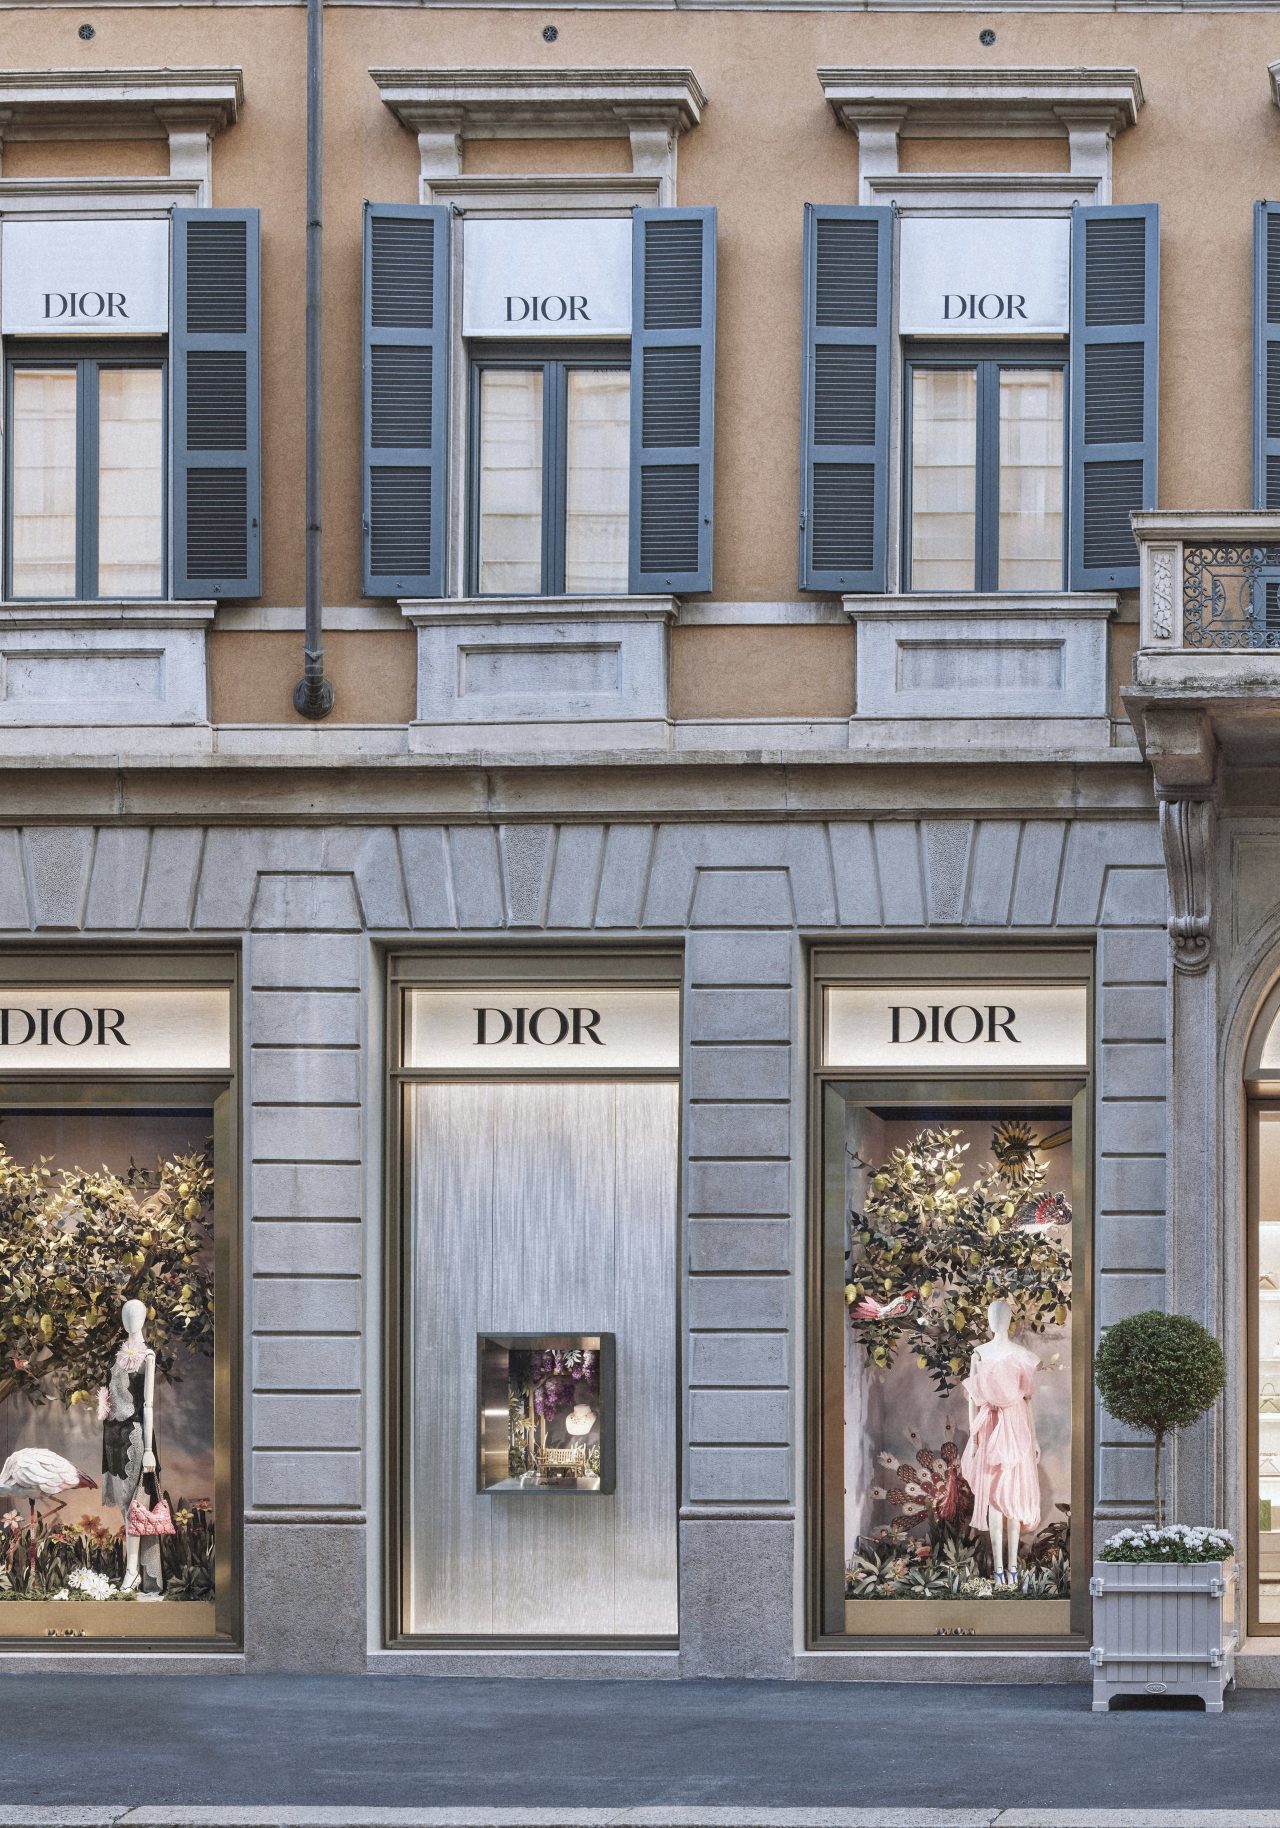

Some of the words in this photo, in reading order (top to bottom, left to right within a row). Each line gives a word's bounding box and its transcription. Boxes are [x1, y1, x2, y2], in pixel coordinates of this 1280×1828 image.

[43, 293, 128, 318] DIOR
[507, 296, 591, 321] DIOR
[944, 295, 1028, 319] DIOR
[0, 1008, 131, 1046] DIOR
[474, 1007, 606, 1045] DIOR
[888, 1006, 1021, 1043] DIOR
